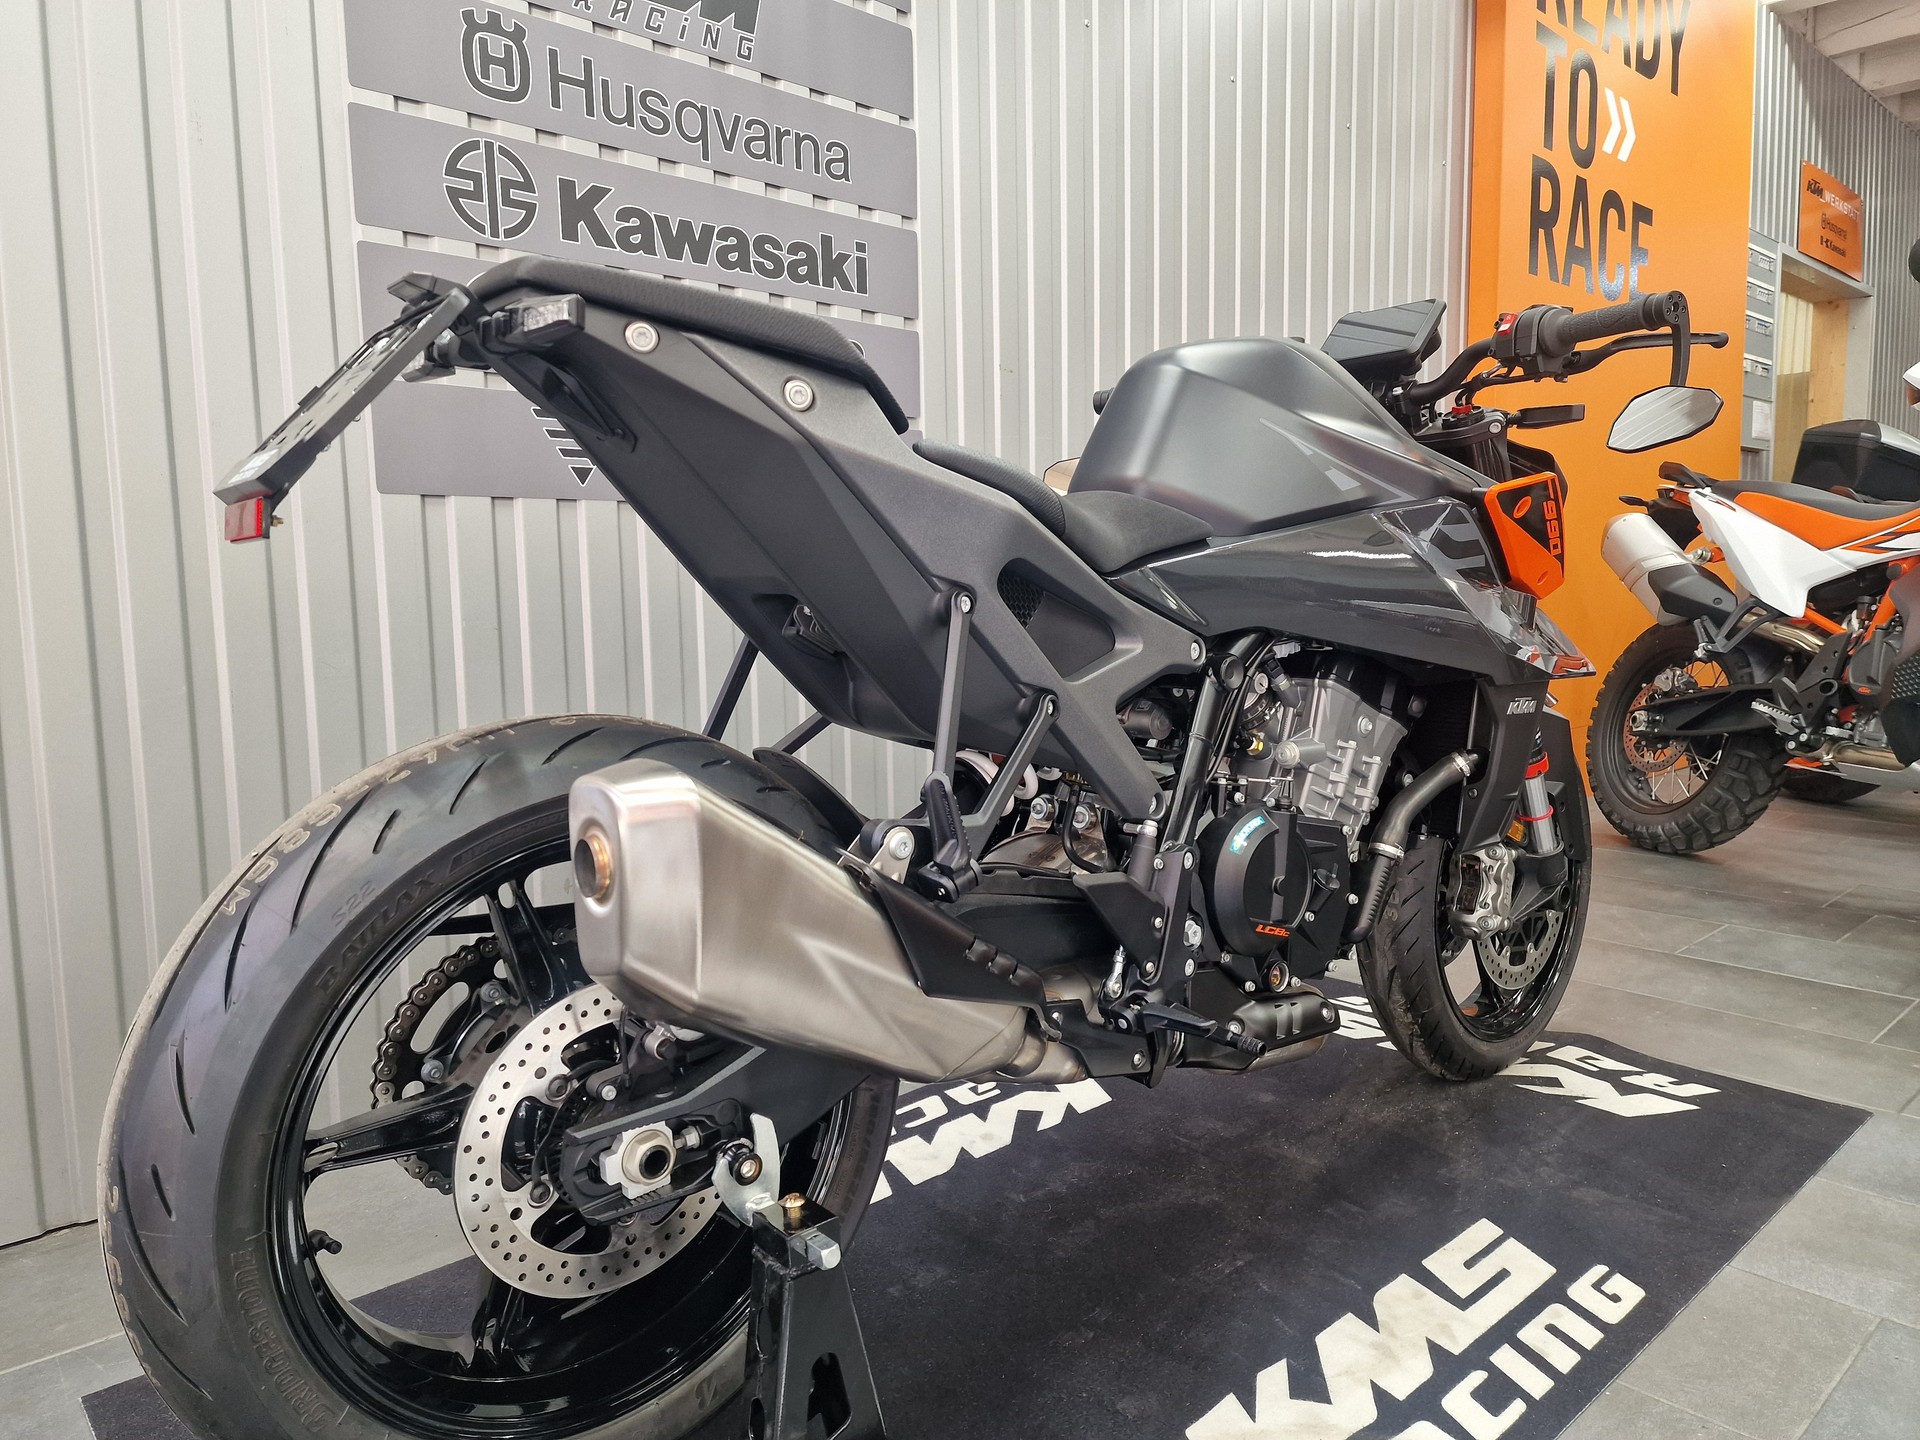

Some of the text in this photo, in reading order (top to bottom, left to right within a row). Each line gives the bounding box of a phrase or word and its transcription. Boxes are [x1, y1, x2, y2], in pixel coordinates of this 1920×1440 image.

[546, 46, 854, 184] Husqvarna
[1535, 19, 1598, 170] TO
[556, 175, 869, 296] Kawasaki
[1528, 153, 1653, 301] RACE
[1543, 500, 1562, 556] 990
[1507, 697, 1537, 715] KTM
